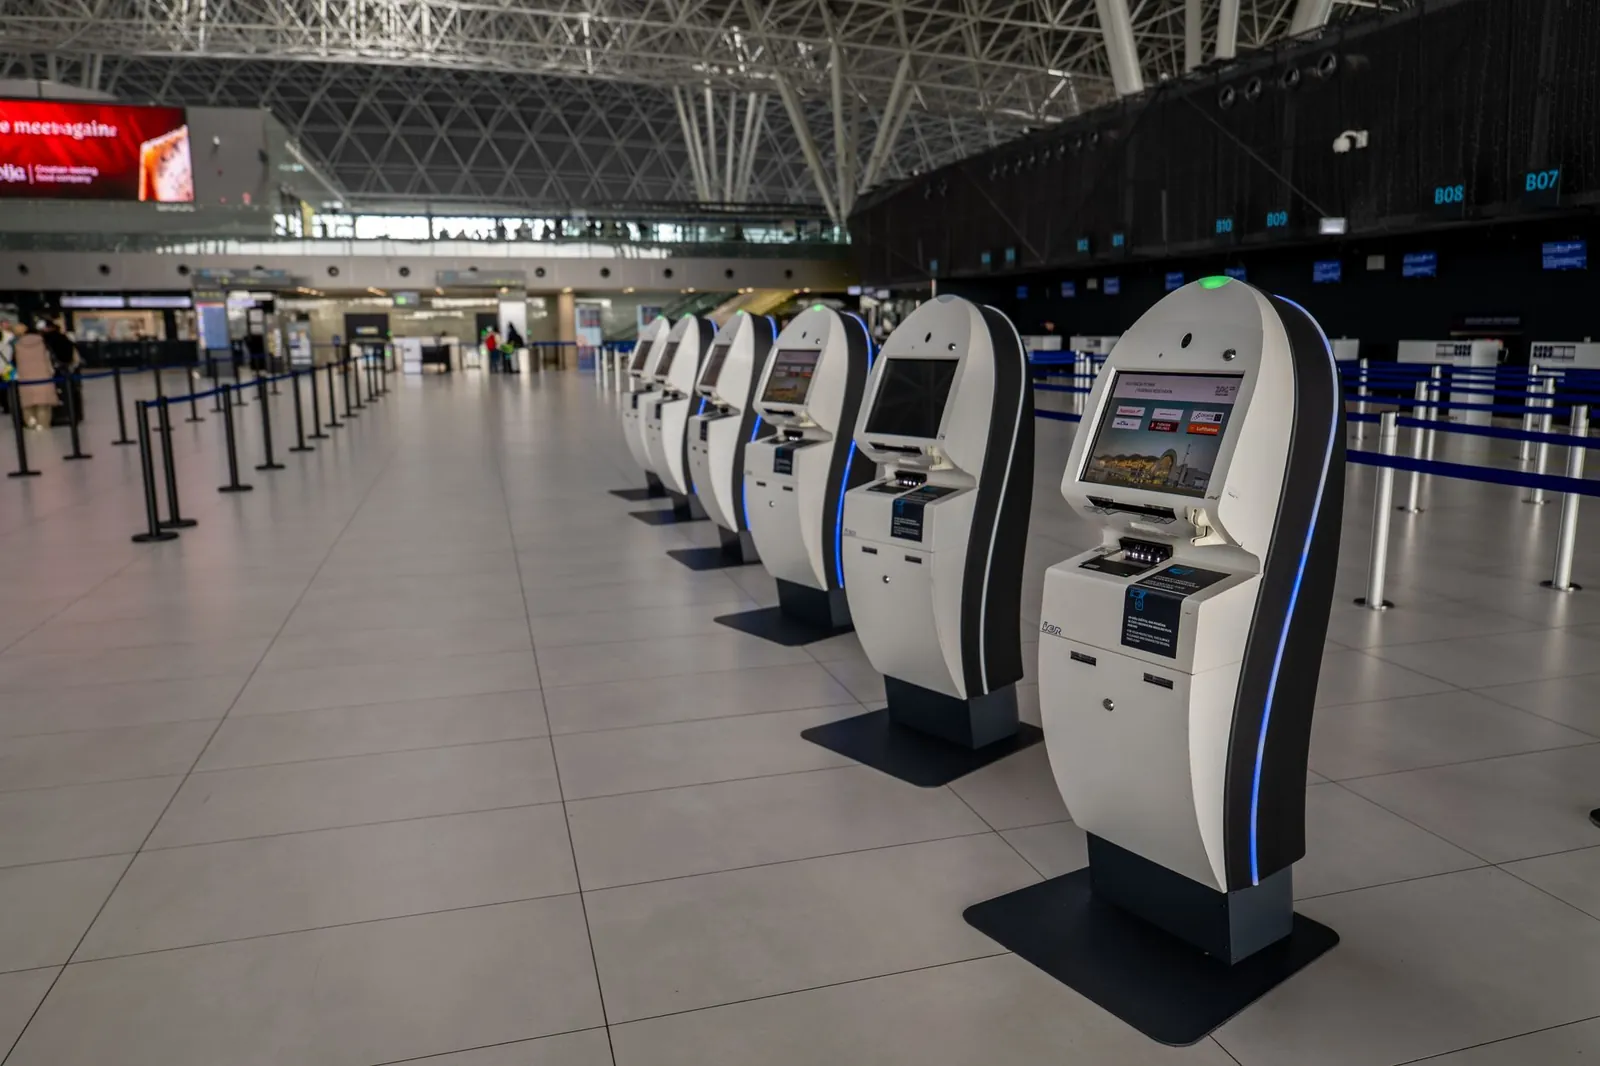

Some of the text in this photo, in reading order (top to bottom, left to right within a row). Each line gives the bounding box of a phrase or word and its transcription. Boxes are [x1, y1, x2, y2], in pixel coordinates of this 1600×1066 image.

[1525, 169, 1559, 191] B07
[1434, 183, 1465, 205] B08
[1215, 218, 1232, 234] B10
[1266, 211, 1288, 227] B09
